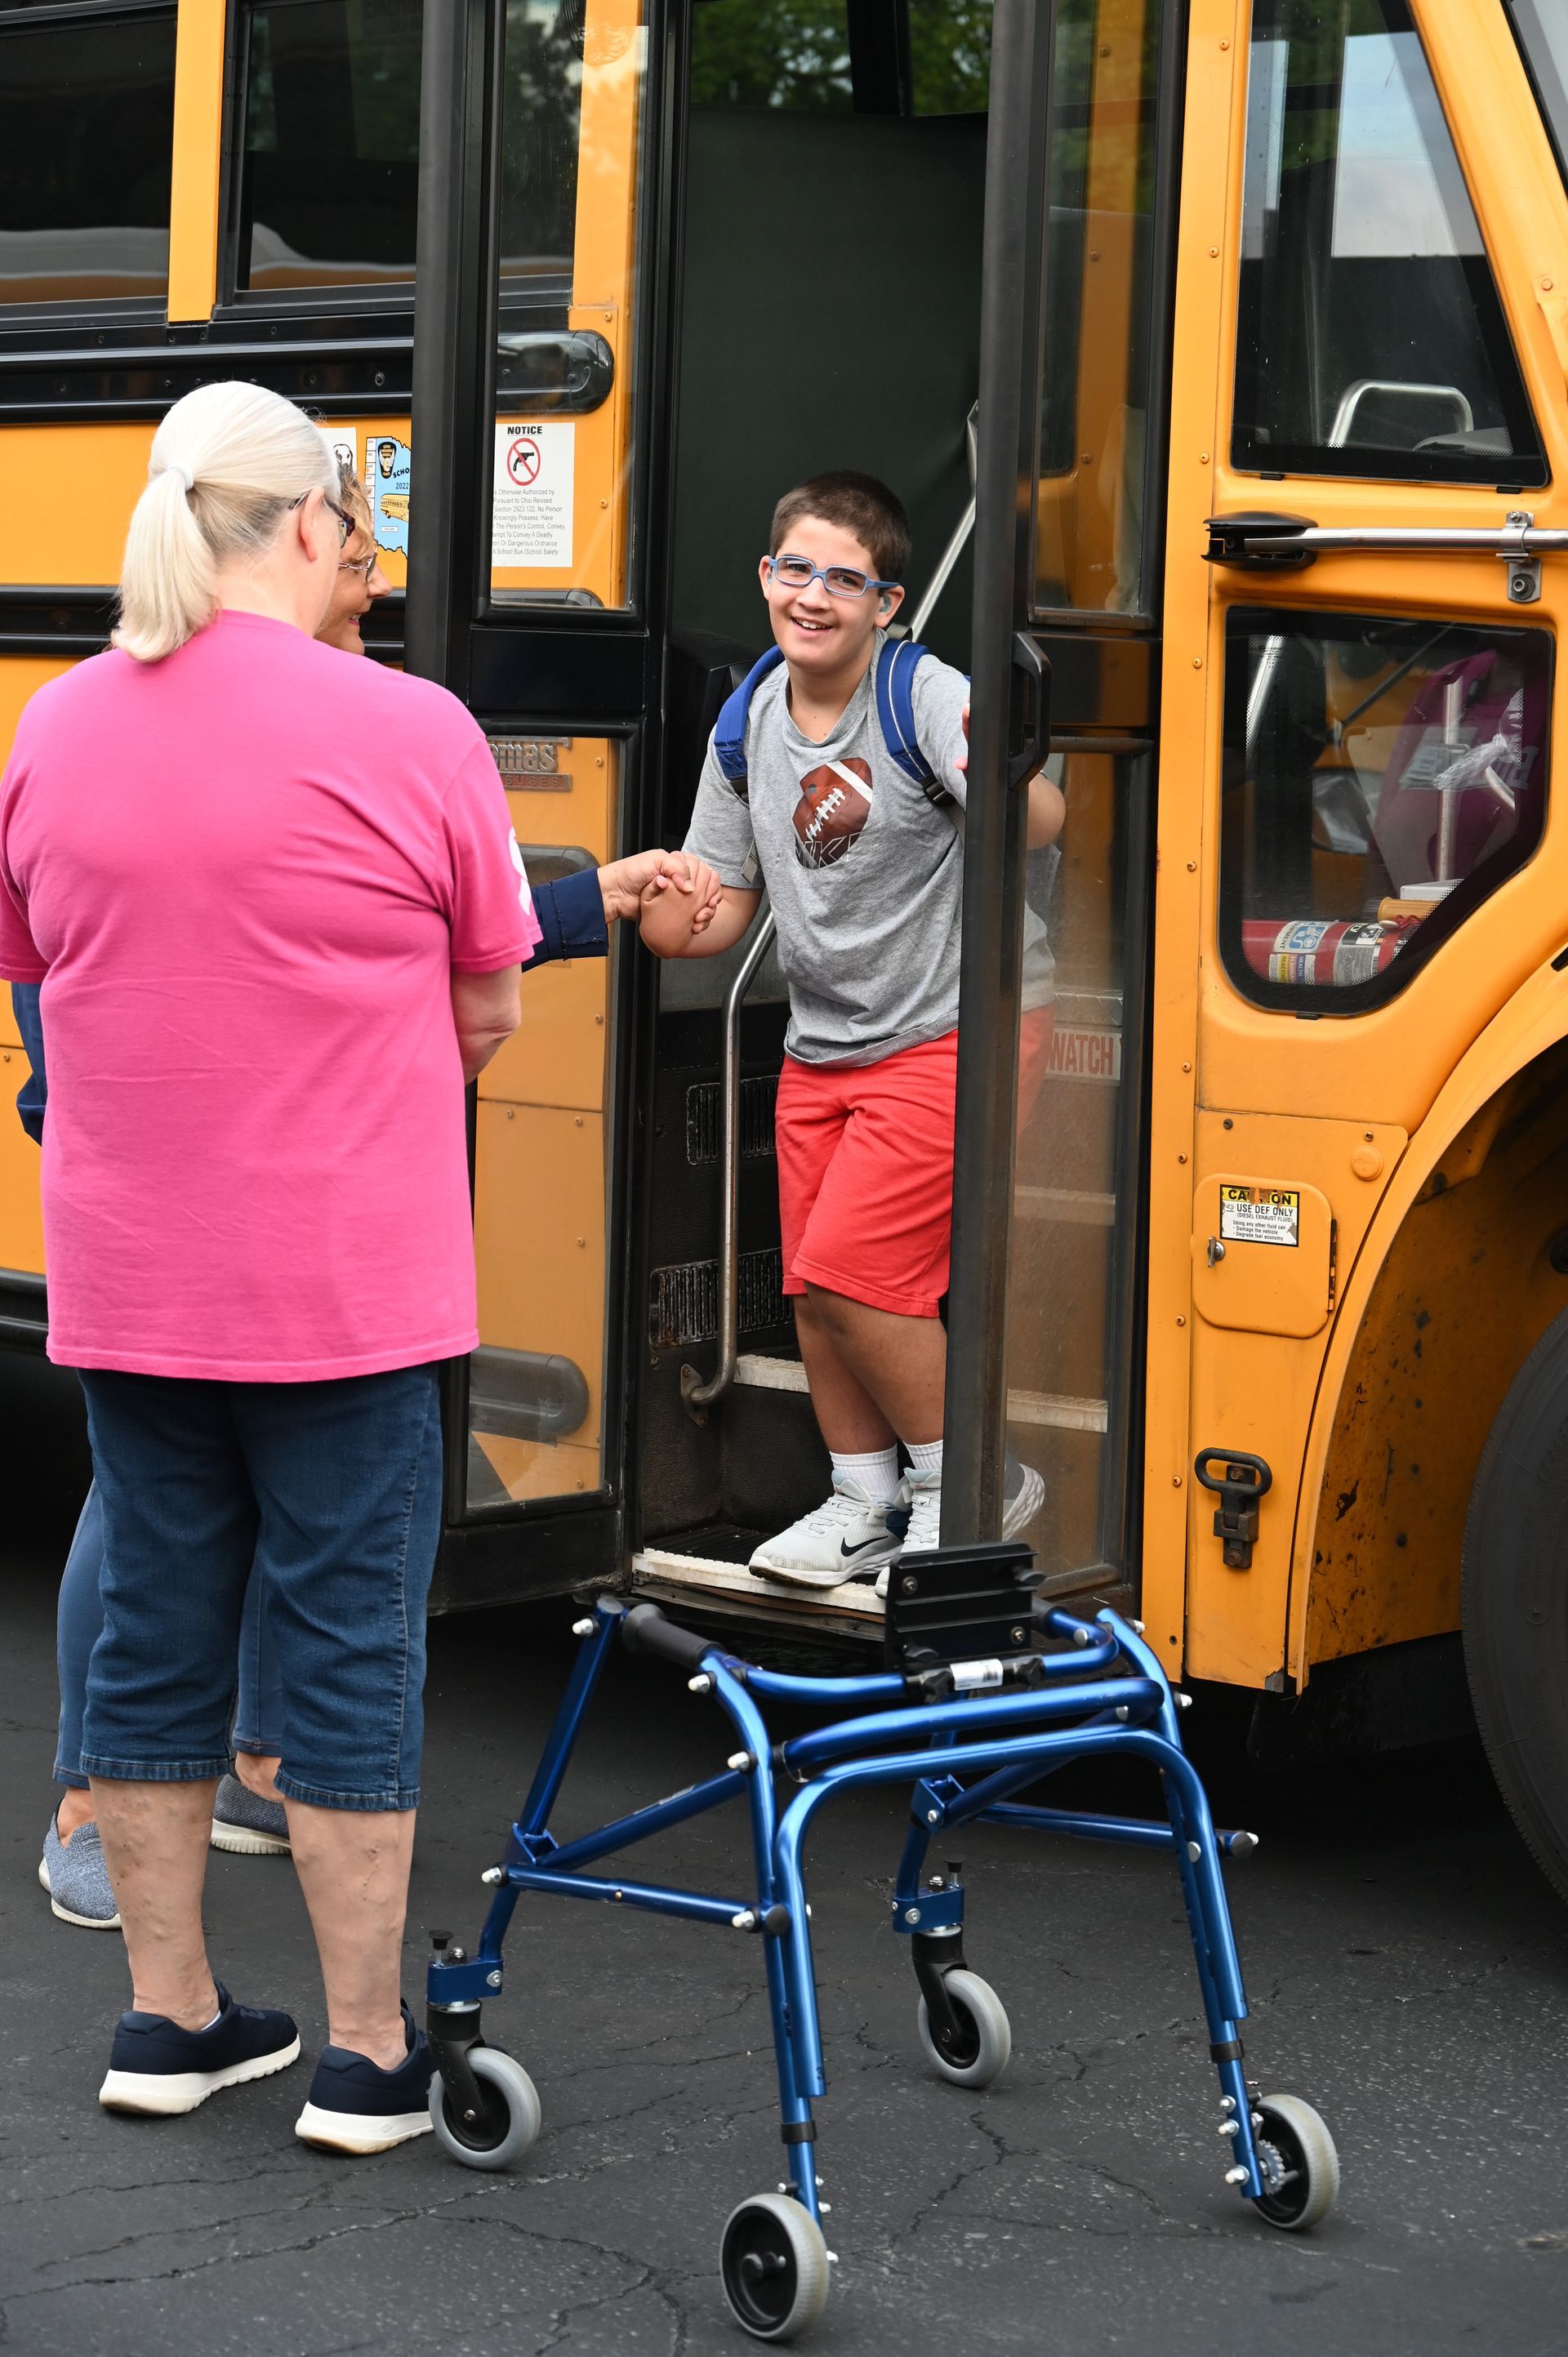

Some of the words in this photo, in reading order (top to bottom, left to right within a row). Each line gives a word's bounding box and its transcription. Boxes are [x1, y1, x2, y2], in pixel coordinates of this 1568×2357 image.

[507, 426, 543, 434] NOTICE
[392, 467, 410, 479] SCHO
[549, 488, 555, 497] by
[513, 531, 531, 539] Convey
[537, 531, 553, 539] Deadly
[1047, 1031, 1114, 1076] WATCH
[1228, 1189, 1291, 1205] CAON
[1236, 1203, 1252, 1214] USE
[1254, 1205, 1270, 1214] DEF
[1272, 1206, 1294, 1217] ONLY
